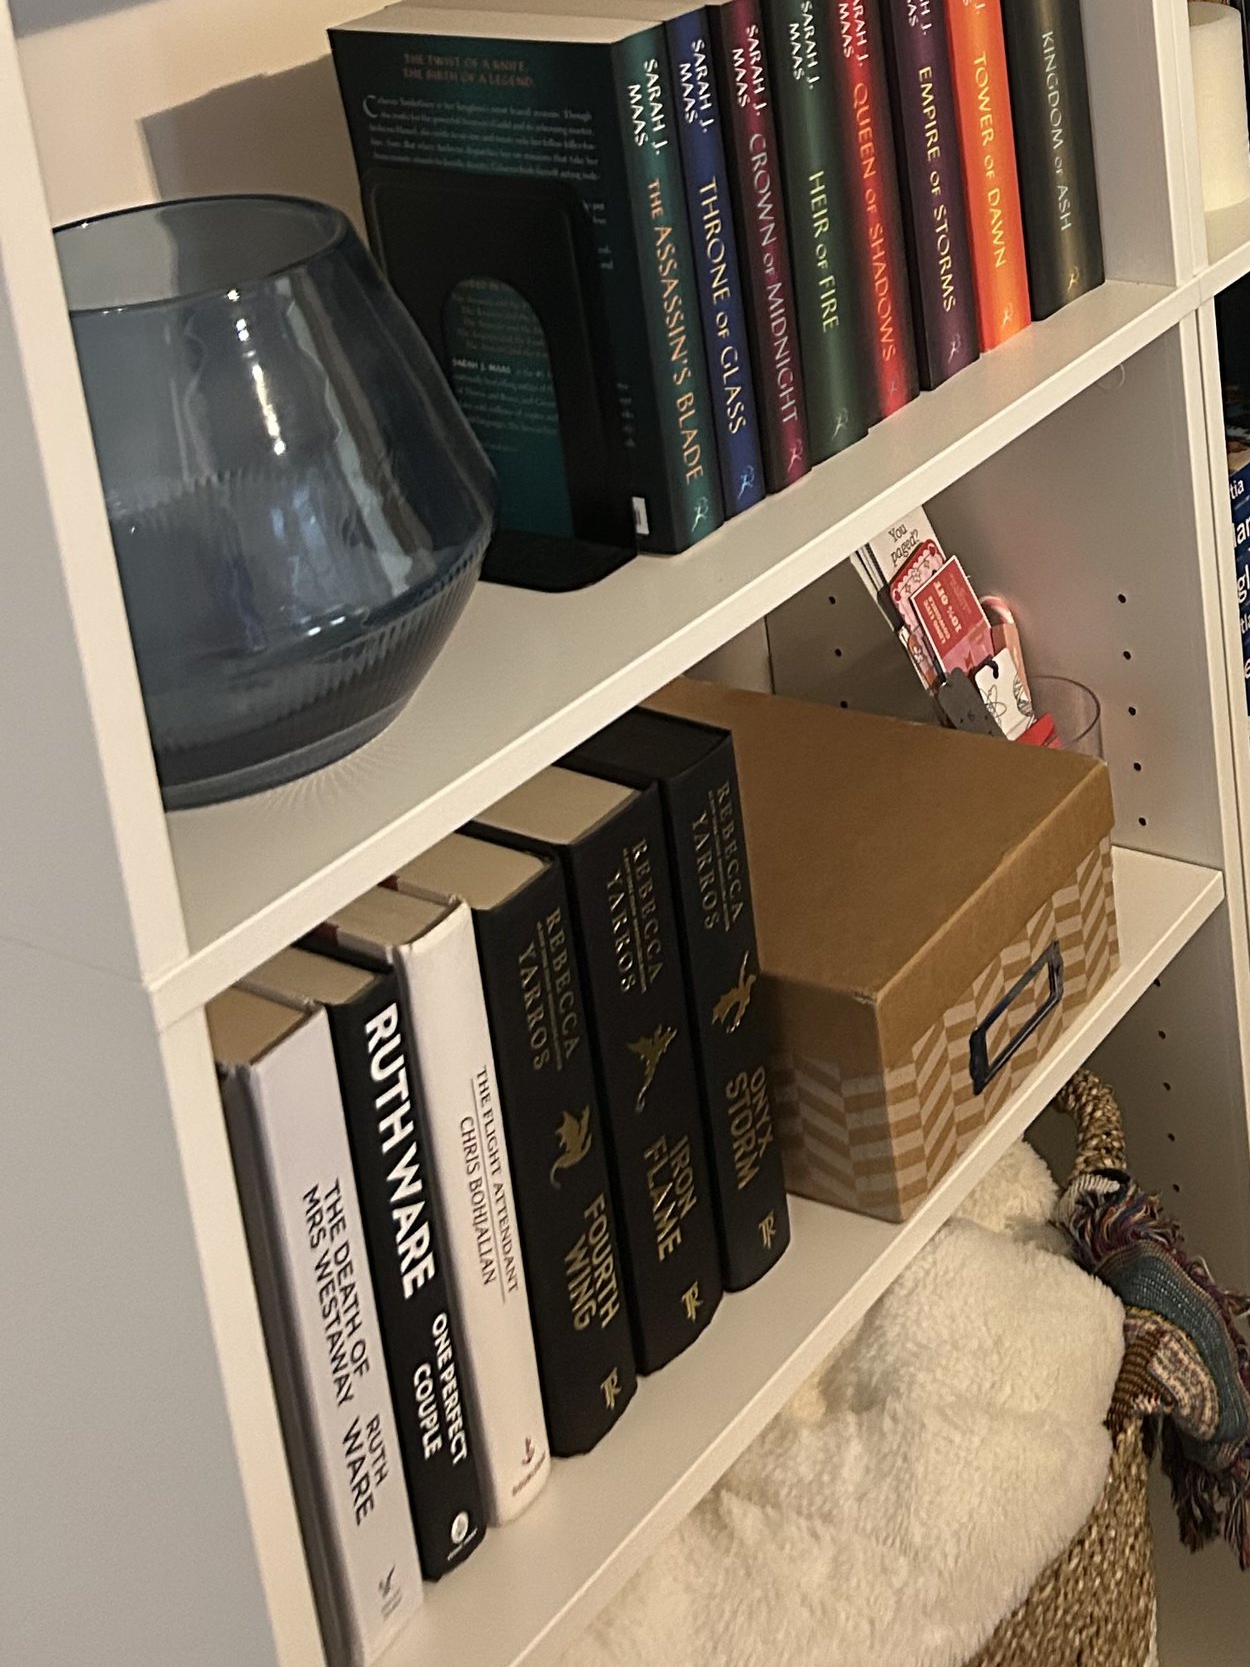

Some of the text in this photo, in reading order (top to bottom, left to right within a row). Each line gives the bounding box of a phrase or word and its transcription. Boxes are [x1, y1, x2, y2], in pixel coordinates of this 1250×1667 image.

[644, 58, 666, 133] SARAH
[679, 63, 698, 124] MAAS
[691, 39, 713, 111] SARAH
[732, 48, 751, 108] MAAS
[747, 24, 766, 94] SARAH
[789, 23, 805, 81] MAAS
[801, 0, 818, 68] SARAH
[838, 3, 855, 59] MAAS
[629, 84, 649, 147] MAAS
[973, 50, 1007, 270] TOWER OF DAWN
[1042, 31, 1072, 232] KINGDOM OF ASH
[808, 170, 840, 334] HEIR OF FIRE
[853, 82, 897, 363] QUEEN OF SHADOWS
[919, 66, 957, 313] EMPIRE OF STORMS
[648, 178, 704, 485] THE ASSASSIN'S BLADE
[699, 175, 747, 435] THRONE OF GLASS
[750, 133, 799, 424] CROWN OF MIDNIGHT
[887, 523, 909, 543] You
[632, 838, 664, 984] REBECCA
[692, 810, 722, 931] YARROS
[717, 781, 745, 926] REBECCA
[546, 906, 581, 1060] REBECCA
[607, 870, 637, 994] YARROS
[519, 940, 550, 1071] YARROS
[365, 1001, 436, 1301] RUTH WARE
[476, 1063, 519, 1293] THE FLIGHT ATTENDANT
[670, 1134, 699, 1222] IRON
[725, 1070, 761, 1192] STORM
[750, 1066, 774, 1159] ONYX
[459, 1115, 497, 1287] CHRIS BOHJALIAN
[584, 1191, 621, 1330] FOURTH
[644, 1133, 682, 1264] FLAME
[303, 1184, 354, 1408] MRS WESTAWAY
[325, 1178, 370, 1378] THE DEATH OF
[564, 1234, 598, 1331] WING
[366, 1413, 389, 1488] RUTH
[413, 1362, 443, 1461] COUPLE
[431, 1312, 468, 1467] ONE PERFECT
[342, 1416, 375, 1527] WARE
